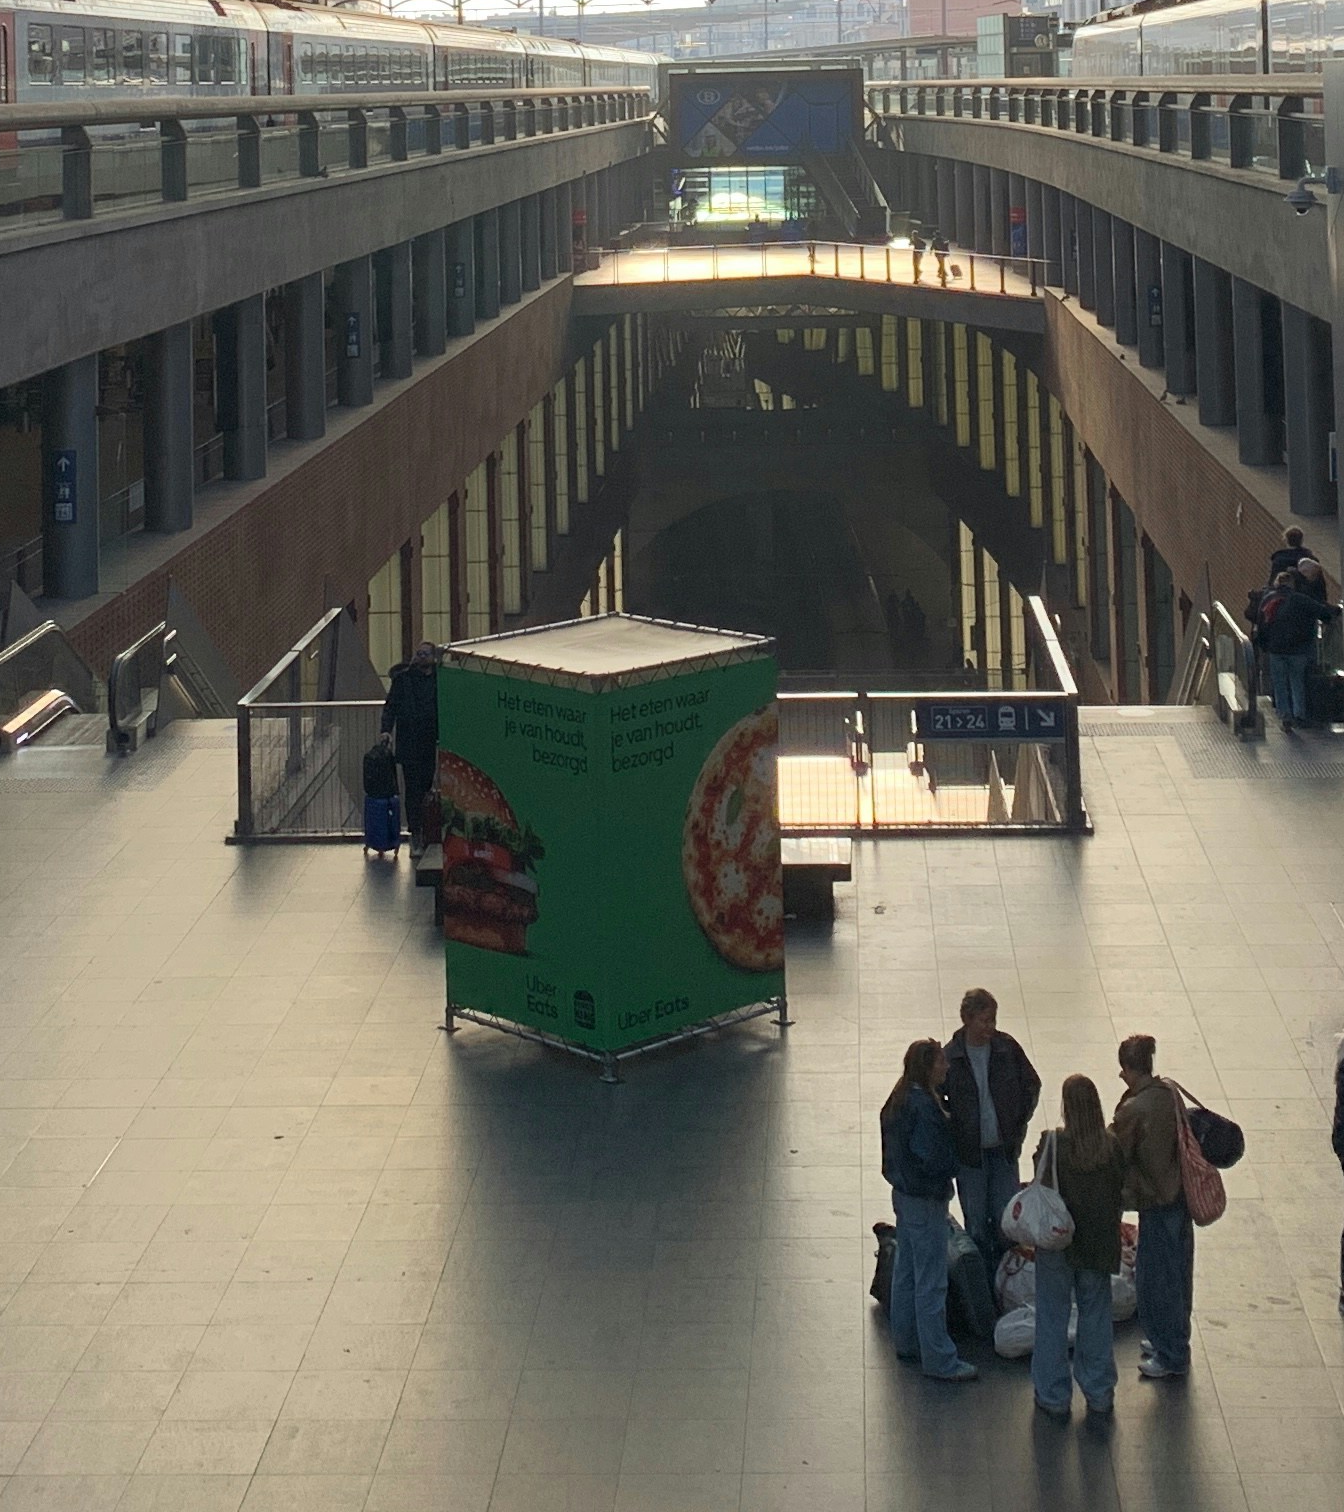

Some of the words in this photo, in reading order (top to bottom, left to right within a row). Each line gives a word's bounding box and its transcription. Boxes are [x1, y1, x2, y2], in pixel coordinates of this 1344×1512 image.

[496, 690, 521, 712] Het
[523, 697, 554, 718] eten
[556, 705, 588, 724] waar
[610, 704, 637, 724] Het
[639, 697, 673, 717] eten
[675, 688, 711, 707] waar
[504, 715, 517, 737] je
[519, 721, 543, 739] van
[611, 731, 623, 753] je
[626, 726, 653, 744] van
[532, 744, 588, 776] bezorgd
[612, 741, 675, 773] bezorgd
[526, 974, 557, 997] Uber
[526, 994, 559, 1019] Eats
[617, 1007, 651, 1031] Uber
[654, 996, 690, 1020] Eats
